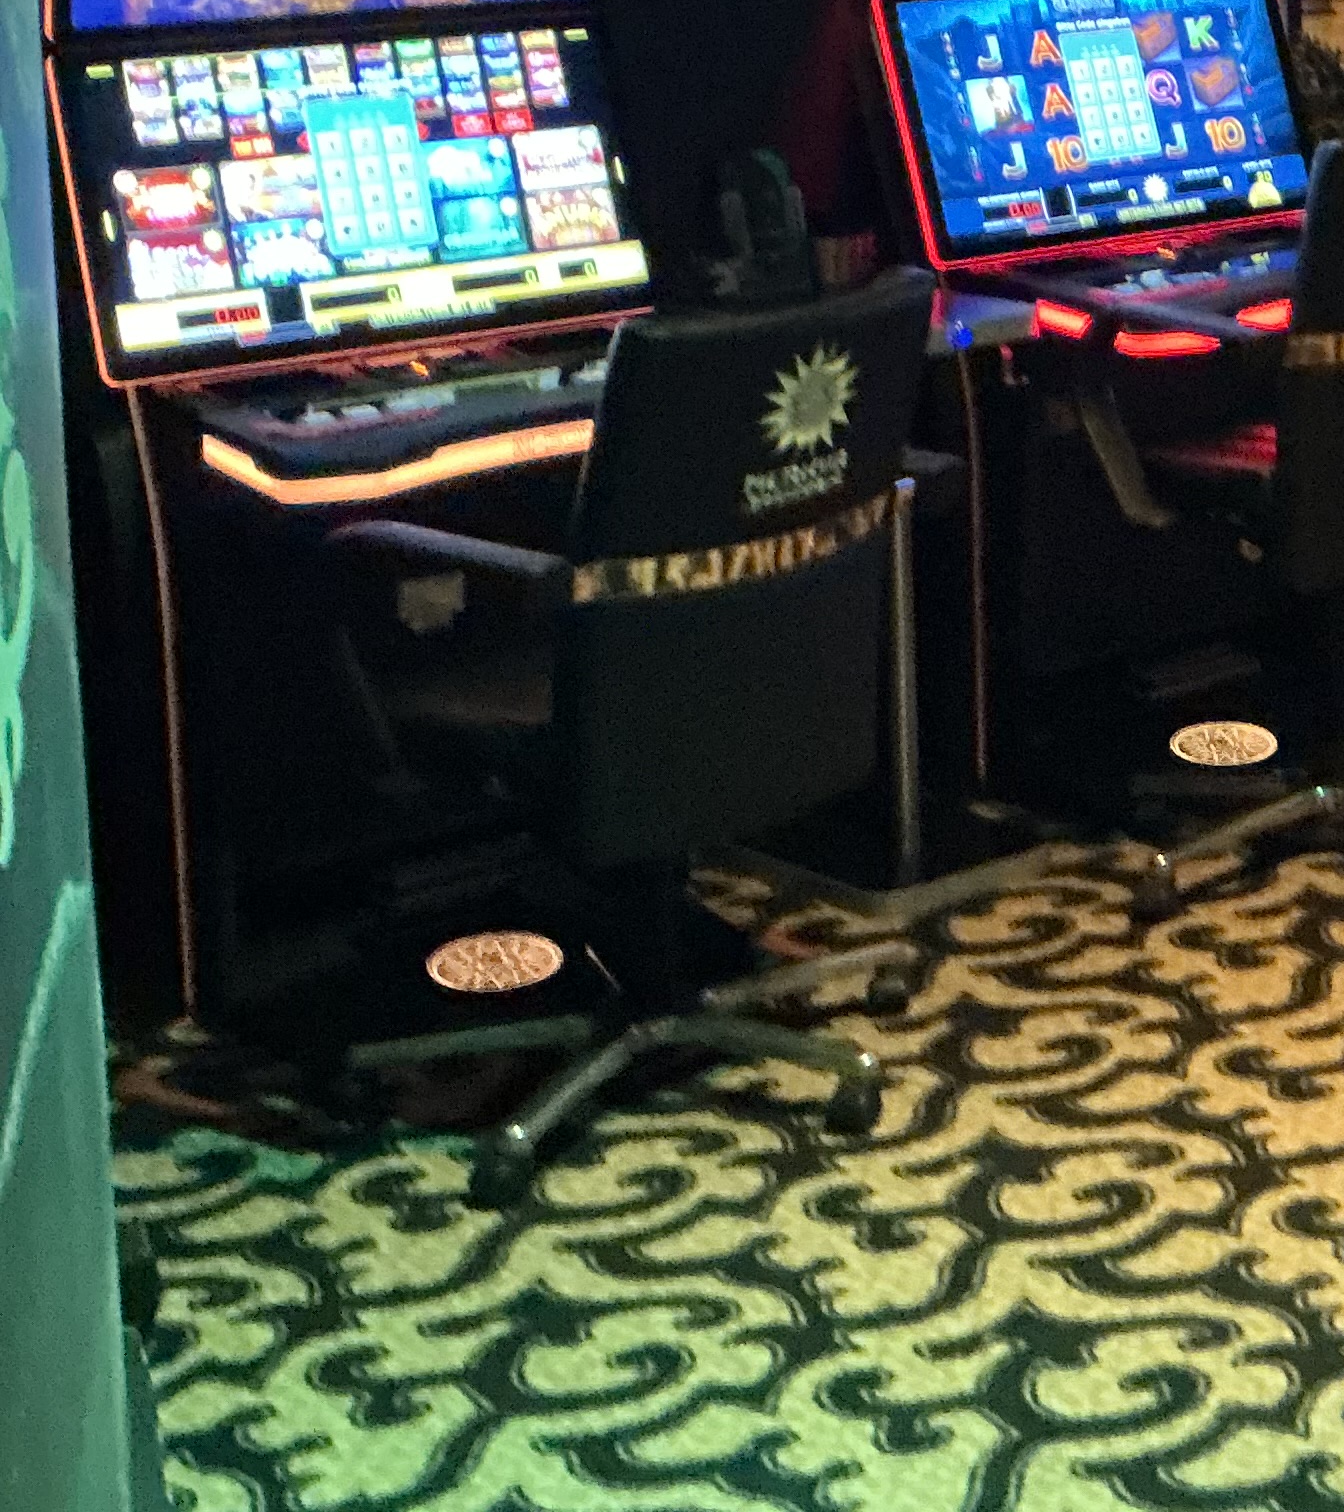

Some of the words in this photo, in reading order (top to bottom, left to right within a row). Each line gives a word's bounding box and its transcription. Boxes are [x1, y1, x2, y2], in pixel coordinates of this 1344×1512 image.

[978, 34, 1003, 71] J
[1029, 29, 1062, 68] A
[1184, 16, 1220, 51] K
[1042, 83, 1074, 120] A
[1146, 69, 1182, 107] Q
[1003, 142, 1028, 179] J
[1047, 135, 1087, 174] 10
[1165, 122, 1188, 159] J
[1204, 116, 1246, 153] 10
